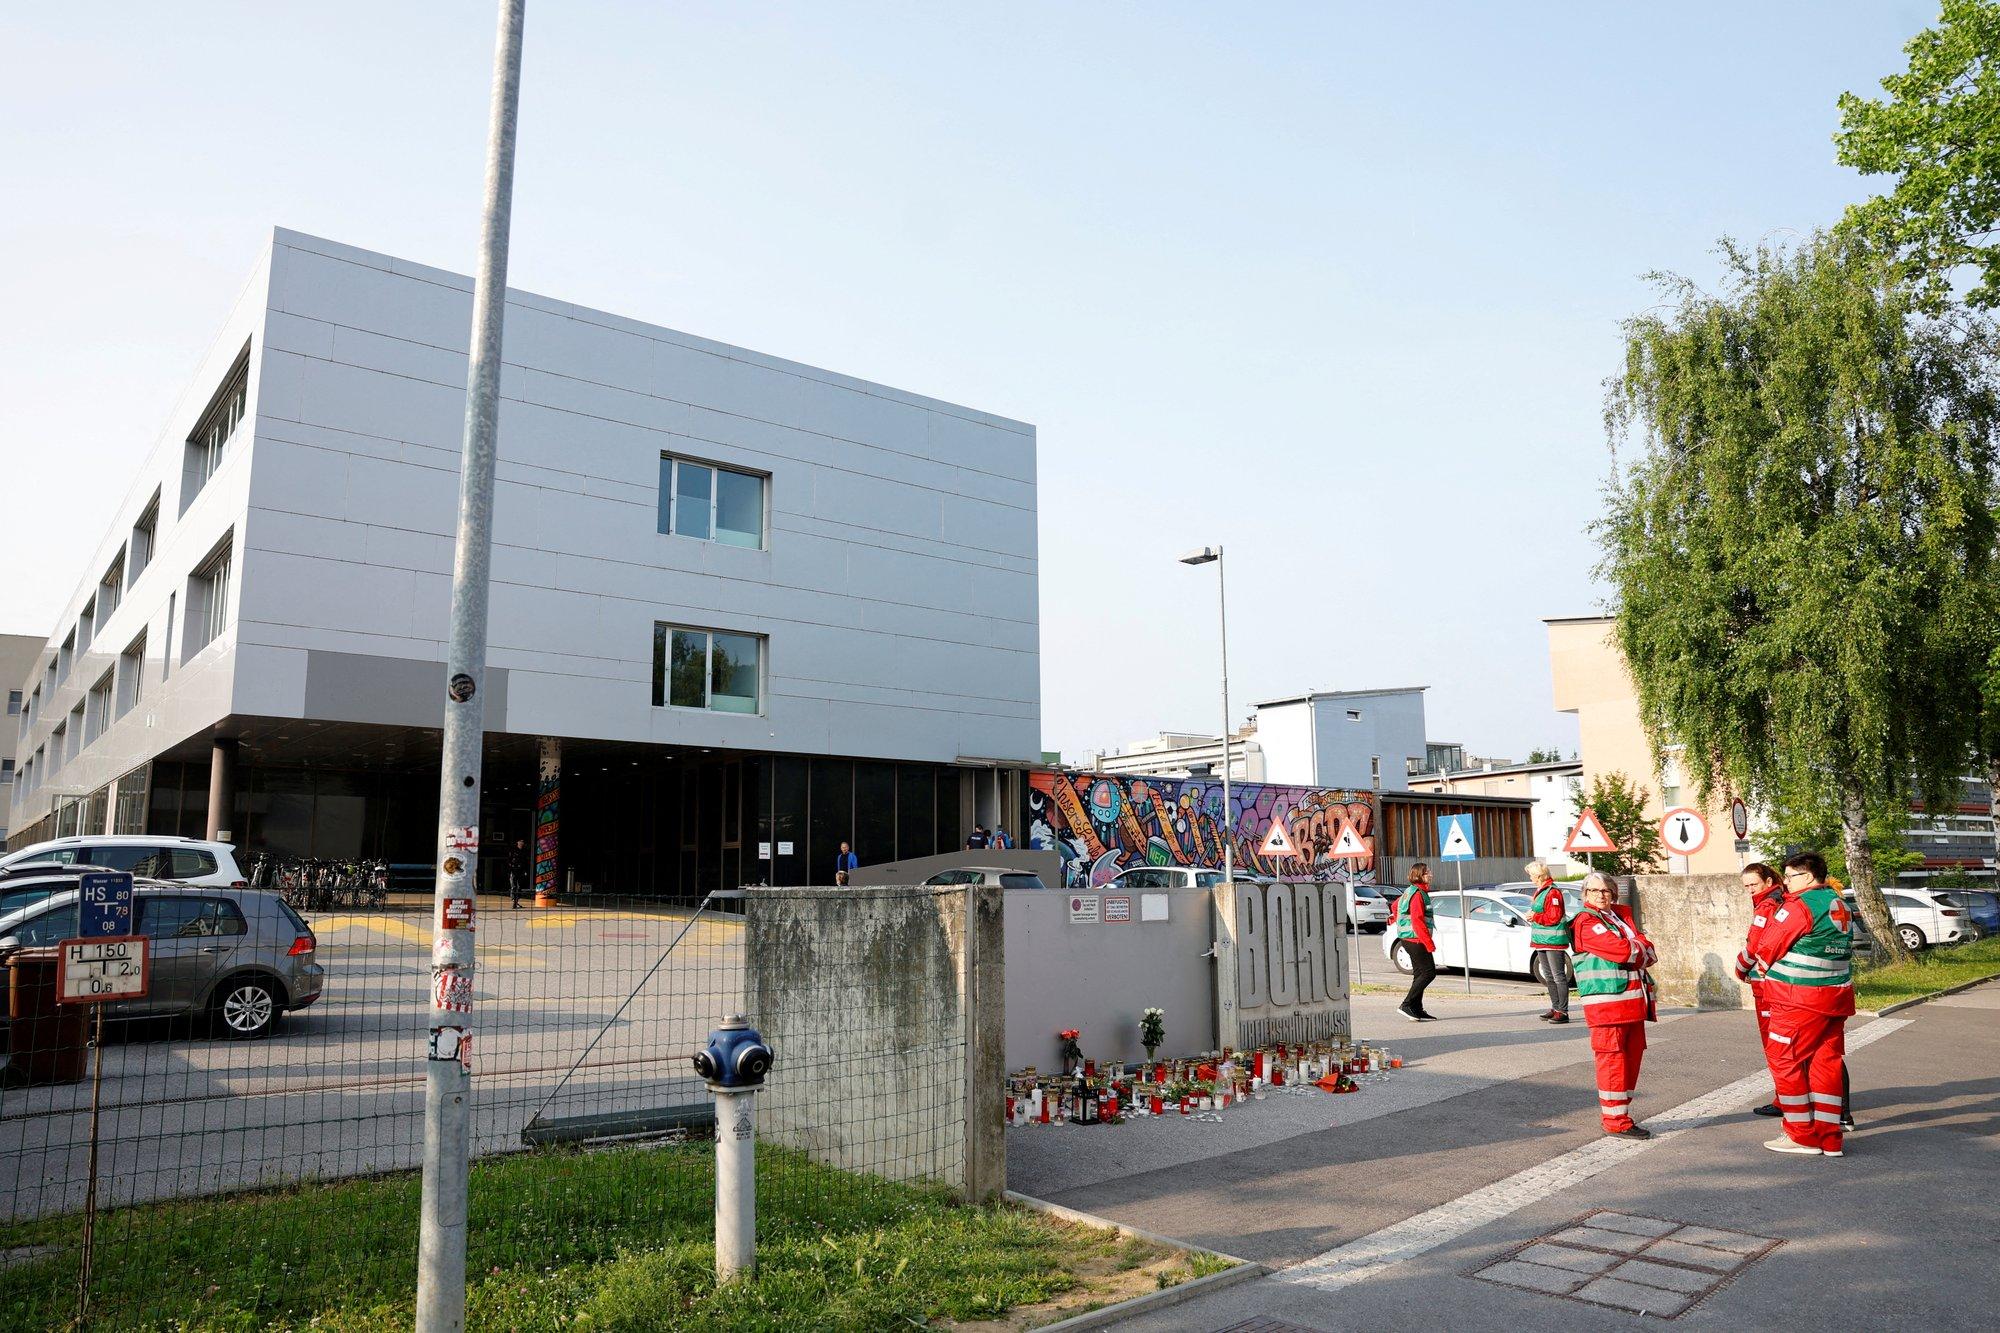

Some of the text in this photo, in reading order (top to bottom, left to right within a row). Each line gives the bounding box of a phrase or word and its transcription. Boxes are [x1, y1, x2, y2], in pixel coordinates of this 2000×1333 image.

[85, 886, 129, 901] HS 80
[71, 943, 126, 959] H 150
[1236, 883, 1350, 1009] BORG
